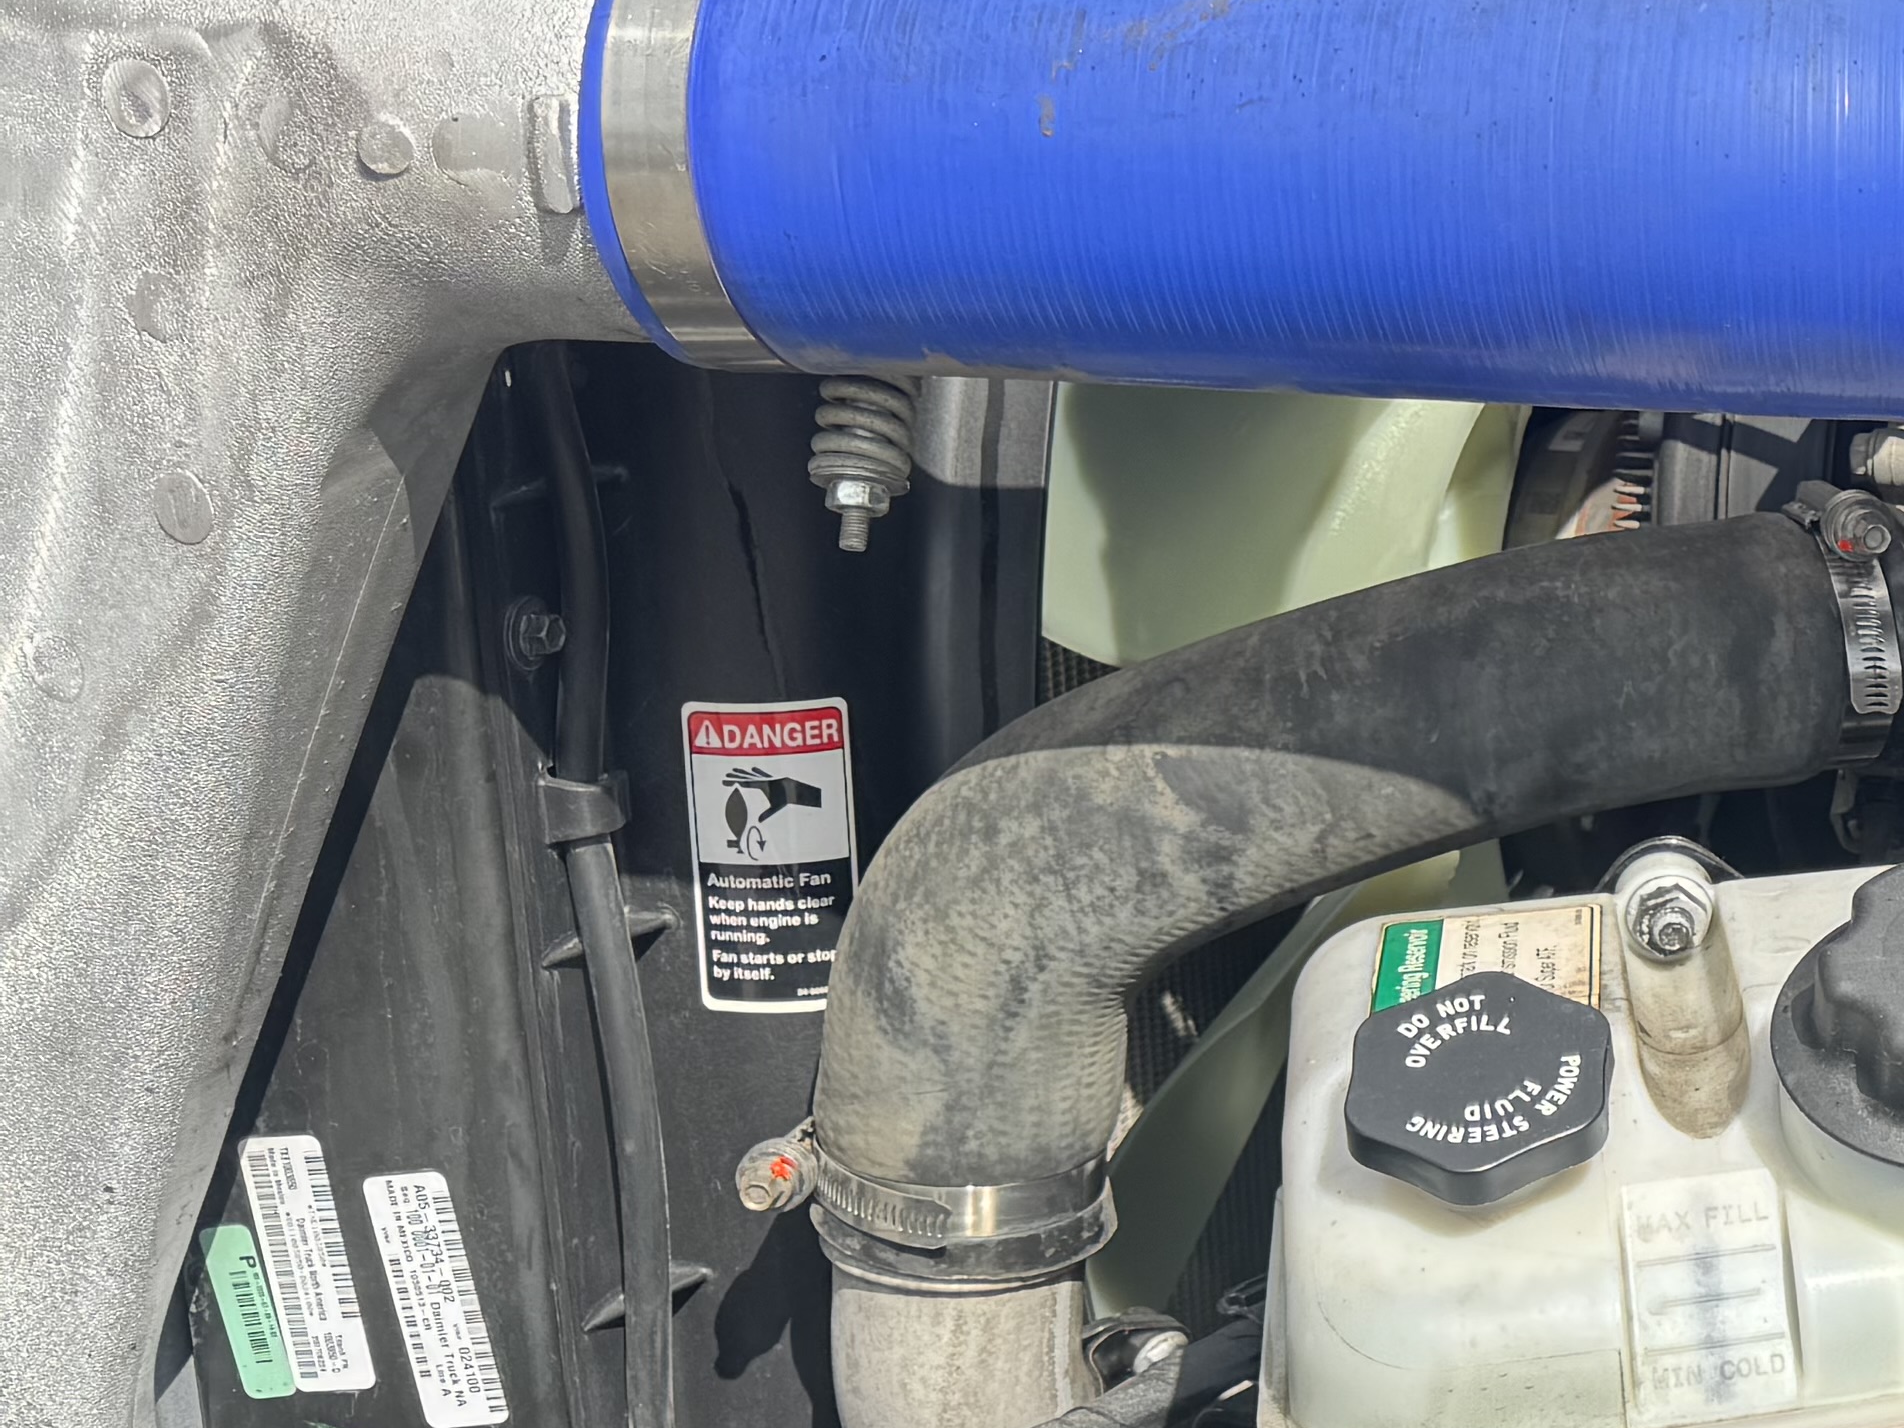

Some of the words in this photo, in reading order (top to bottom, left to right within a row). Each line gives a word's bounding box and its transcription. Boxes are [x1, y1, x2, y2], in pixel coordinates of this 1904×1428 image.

[723, 718, 840, 749] DANGER
[707, 873, 795, 889] Automatic
[799, 873, 831, 887] Fan
[709, 896, 745, 913] Keep
[748, 898, 794, 911] hands
[798, 896, 835, 910] clear
[710, 912, 746, 926] when
[750, 913, 800, 930] engine
[804, 911, 819, 926] is
[711, 930, 771, 945] running.
[1403, 929, 1429, 973] Reservoir
[712, 949, 737, 964] Fan
[740, 951, 784, 965] starts
[787, 952, 804, 964] or
[713, 966, 730, 981] by
[734, 965, 775, 981] itself.
[1397, 1012, 1430, 1038] DO
[1436, 994, 1486, 1019] NOT
[1405, 1014, 1512, 1068] OVERFILL
[1464, 1079, 1542, 1122] FLUID
[1535, 1053, 1581, 1116] POWER
[1405, 1115, 1530, 1143] STEERING
[1636, 1211, 1691, 1237] MAX
[1704, 1201, 1769, 1228] FILL
[238, 1253, 256, 1270] P
[312, 1290, 328, 1322] America
[395, 1224, 415, 1263] MEXICO
[440, 1386, 451, 1397] A
[429, 1300, 452, 1349] Daimler
[442, 1352, 461, 1385] Truck
[453, 1388, 467, 1407] NA
[457, 1344, 481, 1394] 024100
[1651, 1364, 1704, 1390] MIN
[1719, 1353, 1786, 1381] COLD
